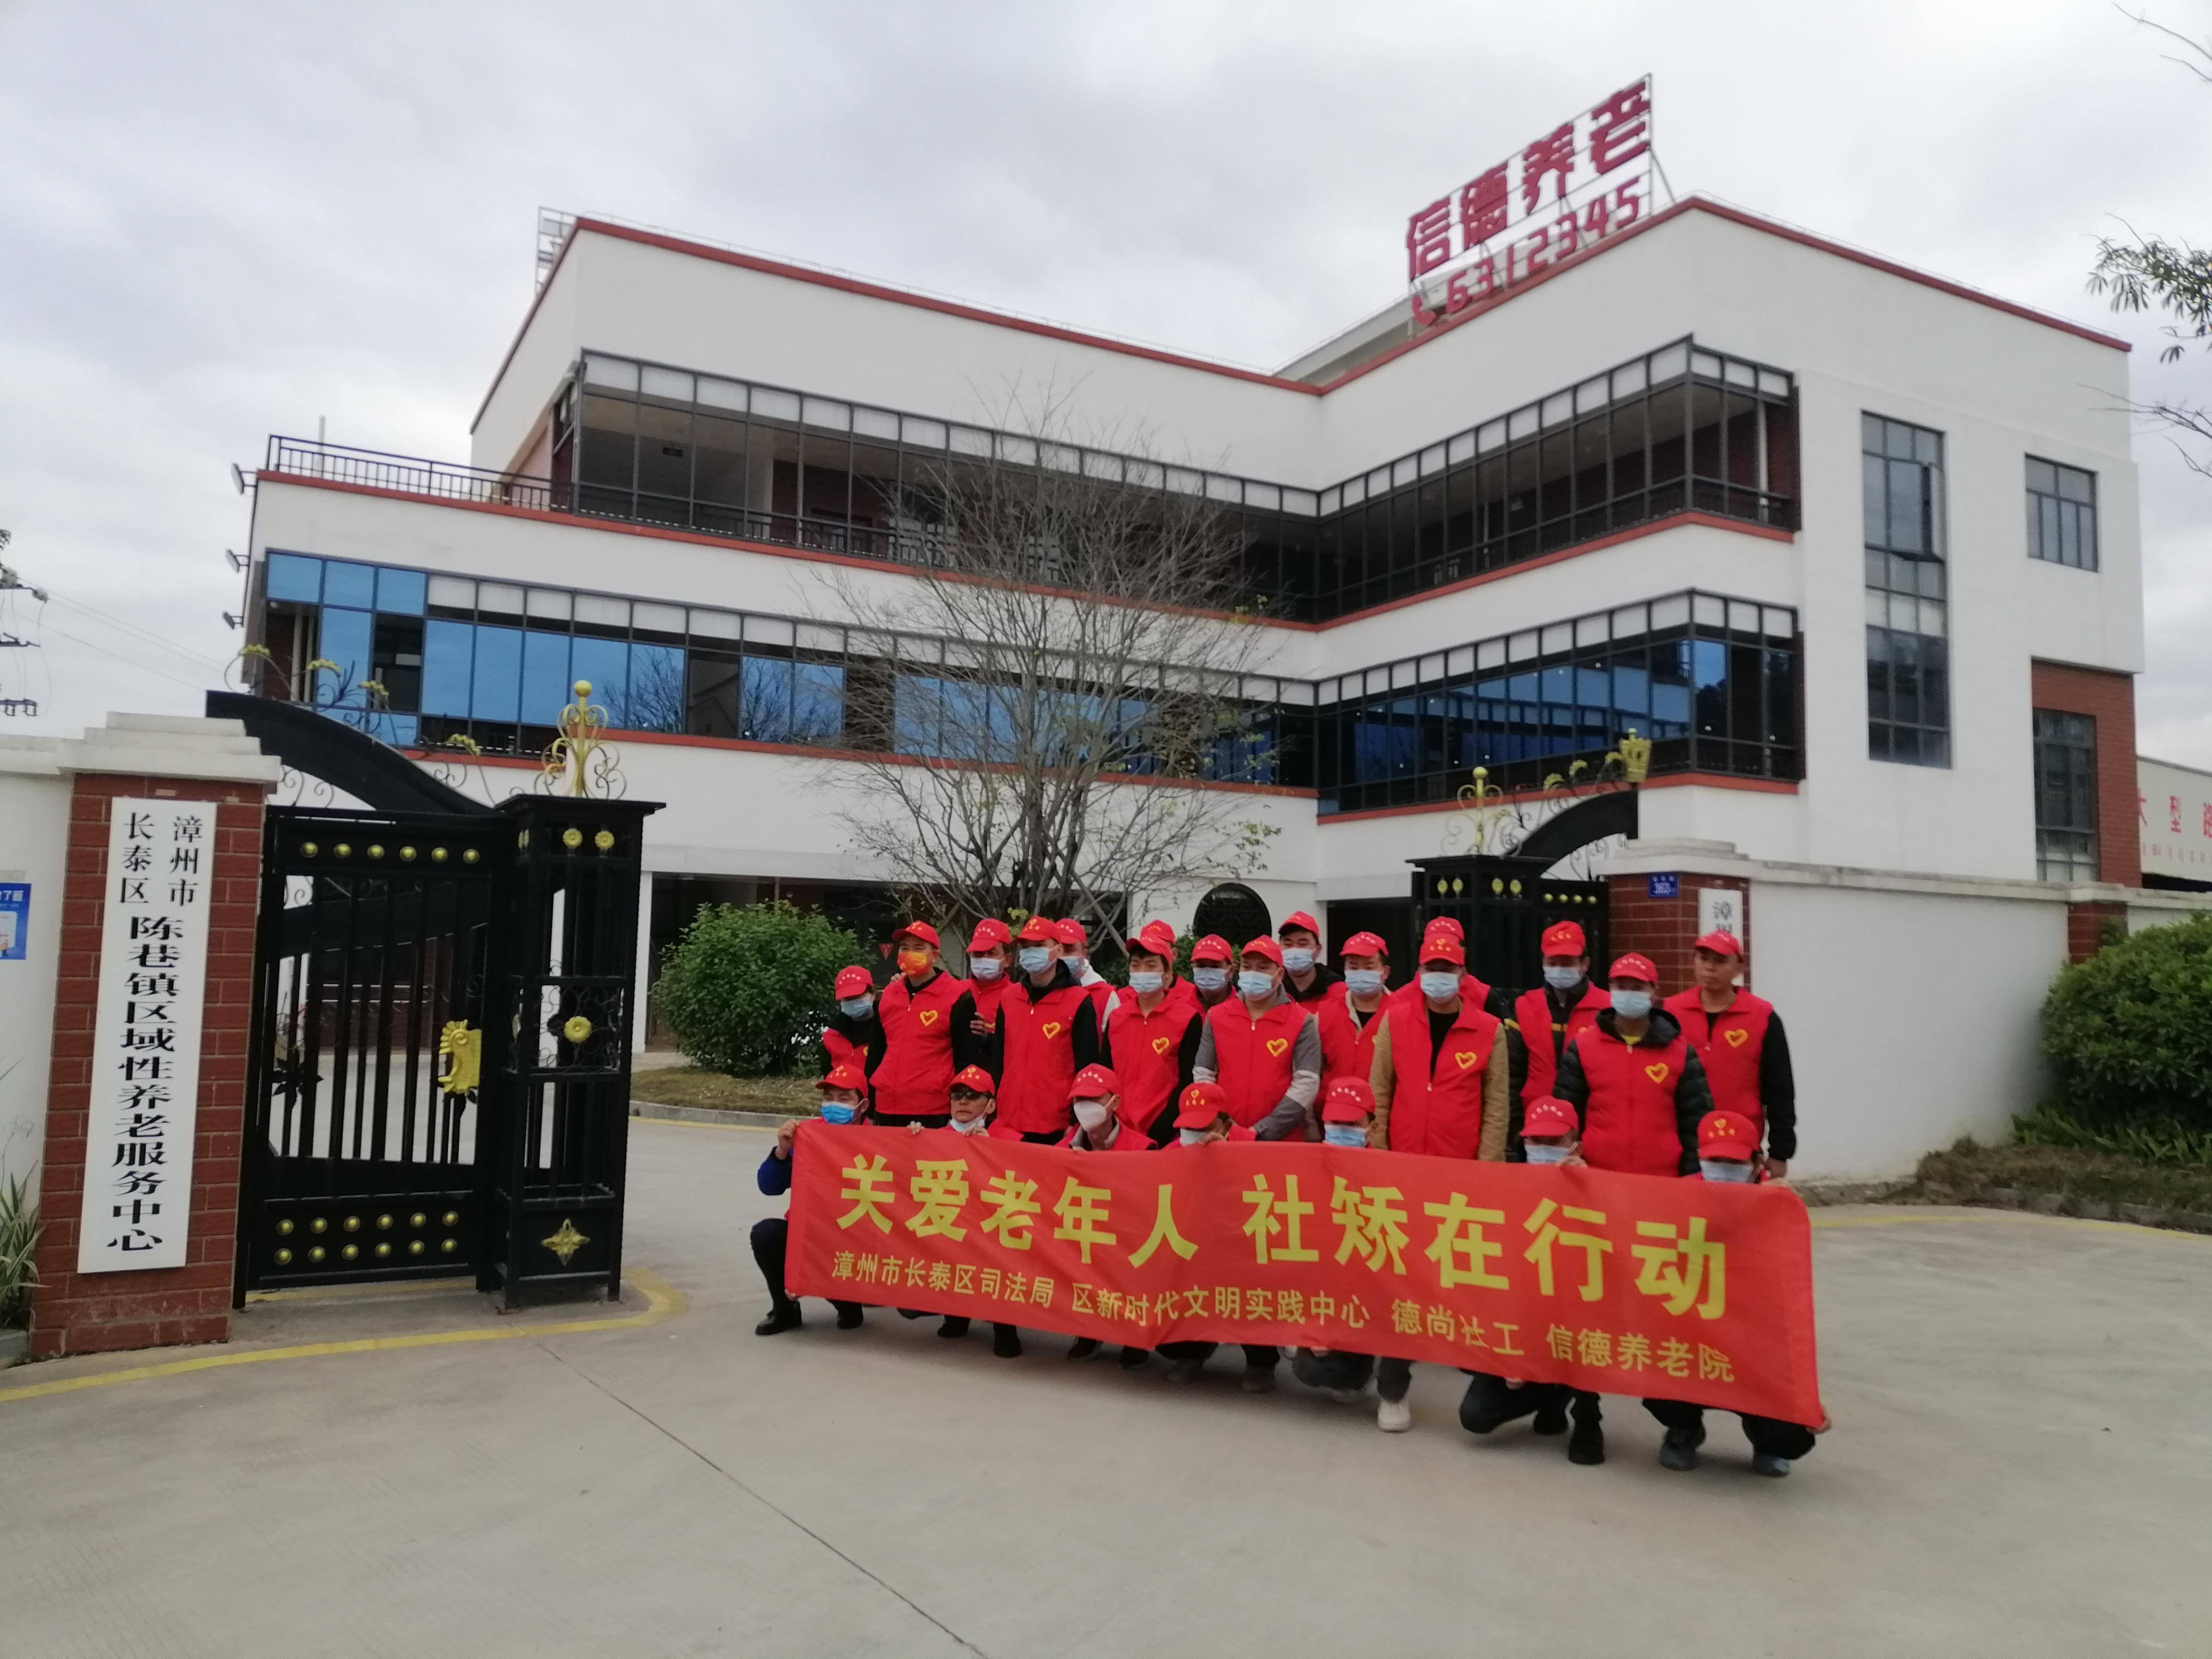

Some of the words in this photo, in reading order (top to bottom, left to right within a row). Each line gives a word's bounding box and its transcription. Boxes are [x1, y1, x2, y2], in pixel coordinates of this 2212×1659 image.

[1407, 81, 1651, 279] 信德养老
[1446, 177, 1640, 313] 6312345
[119, 812, 156, 903] 长泰区
[168, 815, 203, 906] 漳州市
[107, 916, 184, 1251] 陈巷镇区域性养老服务中心
[836, 1154, 1199, 1268] 关爱老年人
[1242, 1174, 1727, 1320] 社矫在行动
[832, 1250, 1054, 1308] 漳州市长泰区司法局
[1071, 1283, 1370, 1329] 区新时代文明实践中心
[1546, 1323, 1735, 1382] 信德养老院
